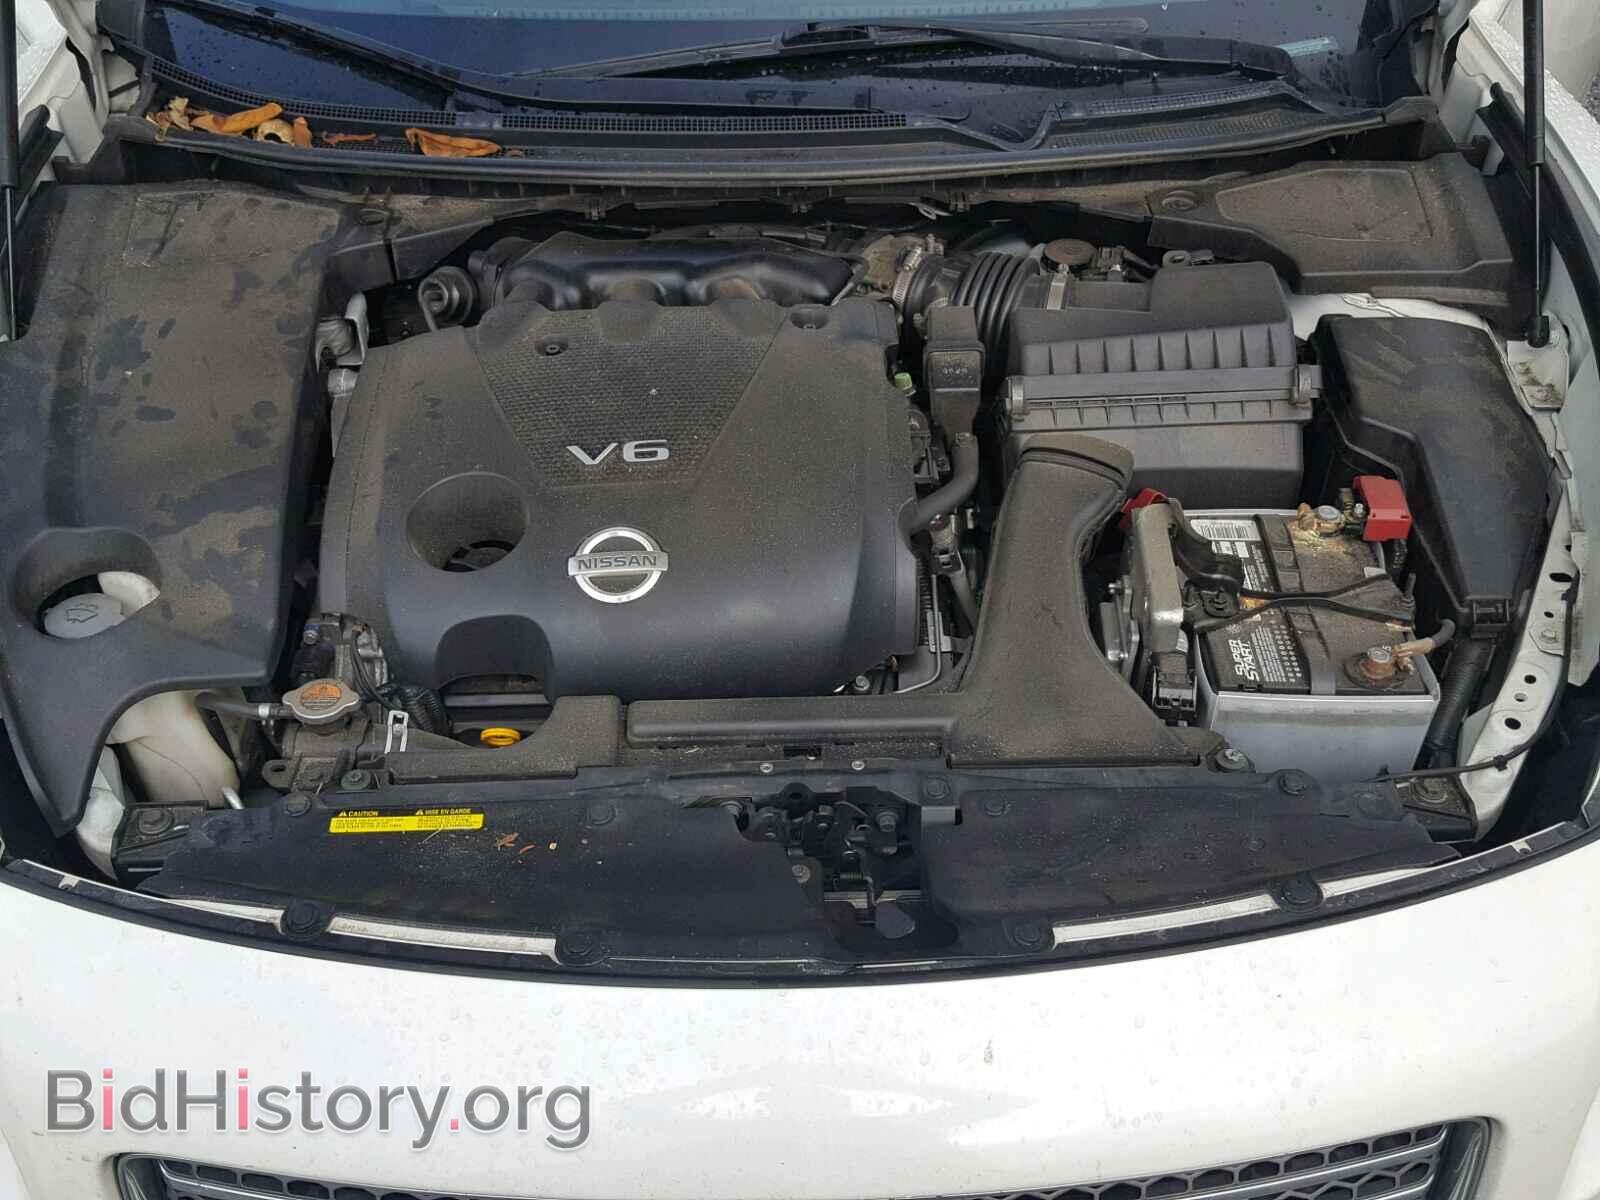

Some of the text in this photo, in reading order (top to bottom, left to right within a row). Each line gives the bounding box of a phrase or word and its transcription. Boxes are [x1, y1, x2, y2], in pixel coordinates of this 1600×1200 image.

[566, 439, 670, 465] V6
[577, 555, 657, 571] NISSAN
[1228, 639, 1245, 676] SUPER
[1237, 638, 1260, 682] START
